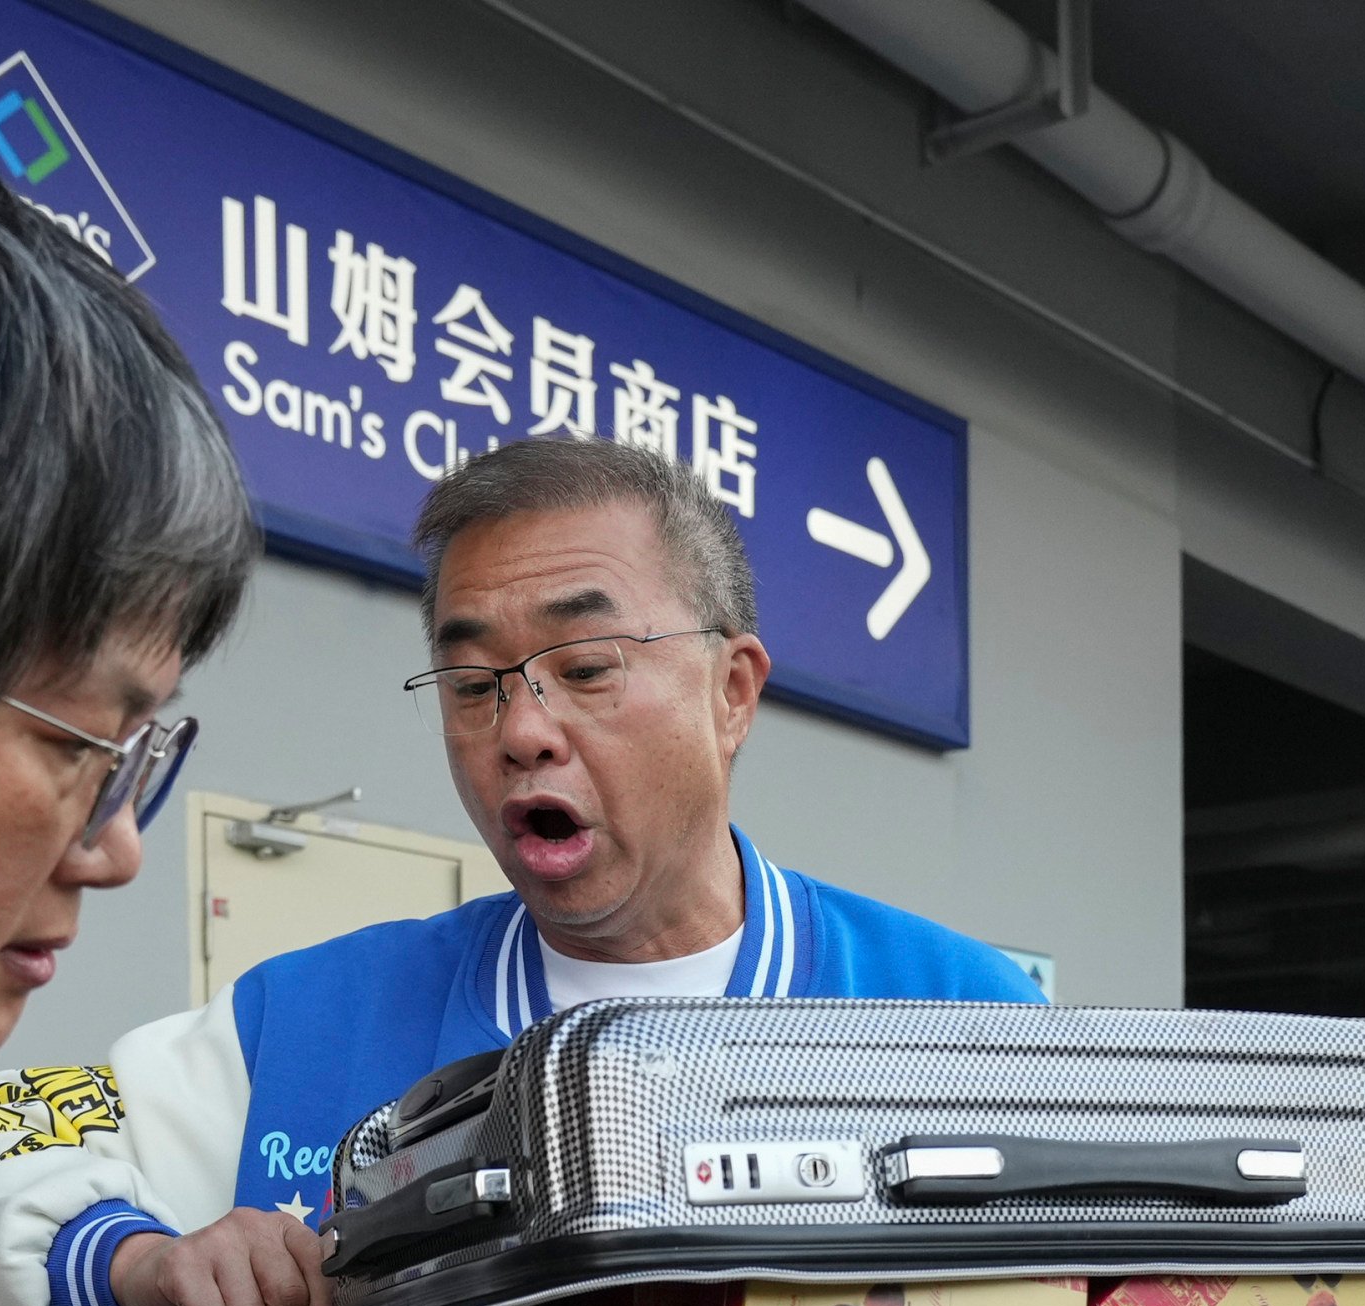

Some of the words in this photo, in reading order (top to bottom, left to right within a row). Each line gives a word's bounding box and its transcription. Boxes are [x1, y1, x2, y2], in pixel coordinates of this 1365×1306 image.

[221, 195, 758, 518] 山姆会员商店
[222, 340, 386, 460] Sam's
[259, 1131, 337, 1181] Rec
